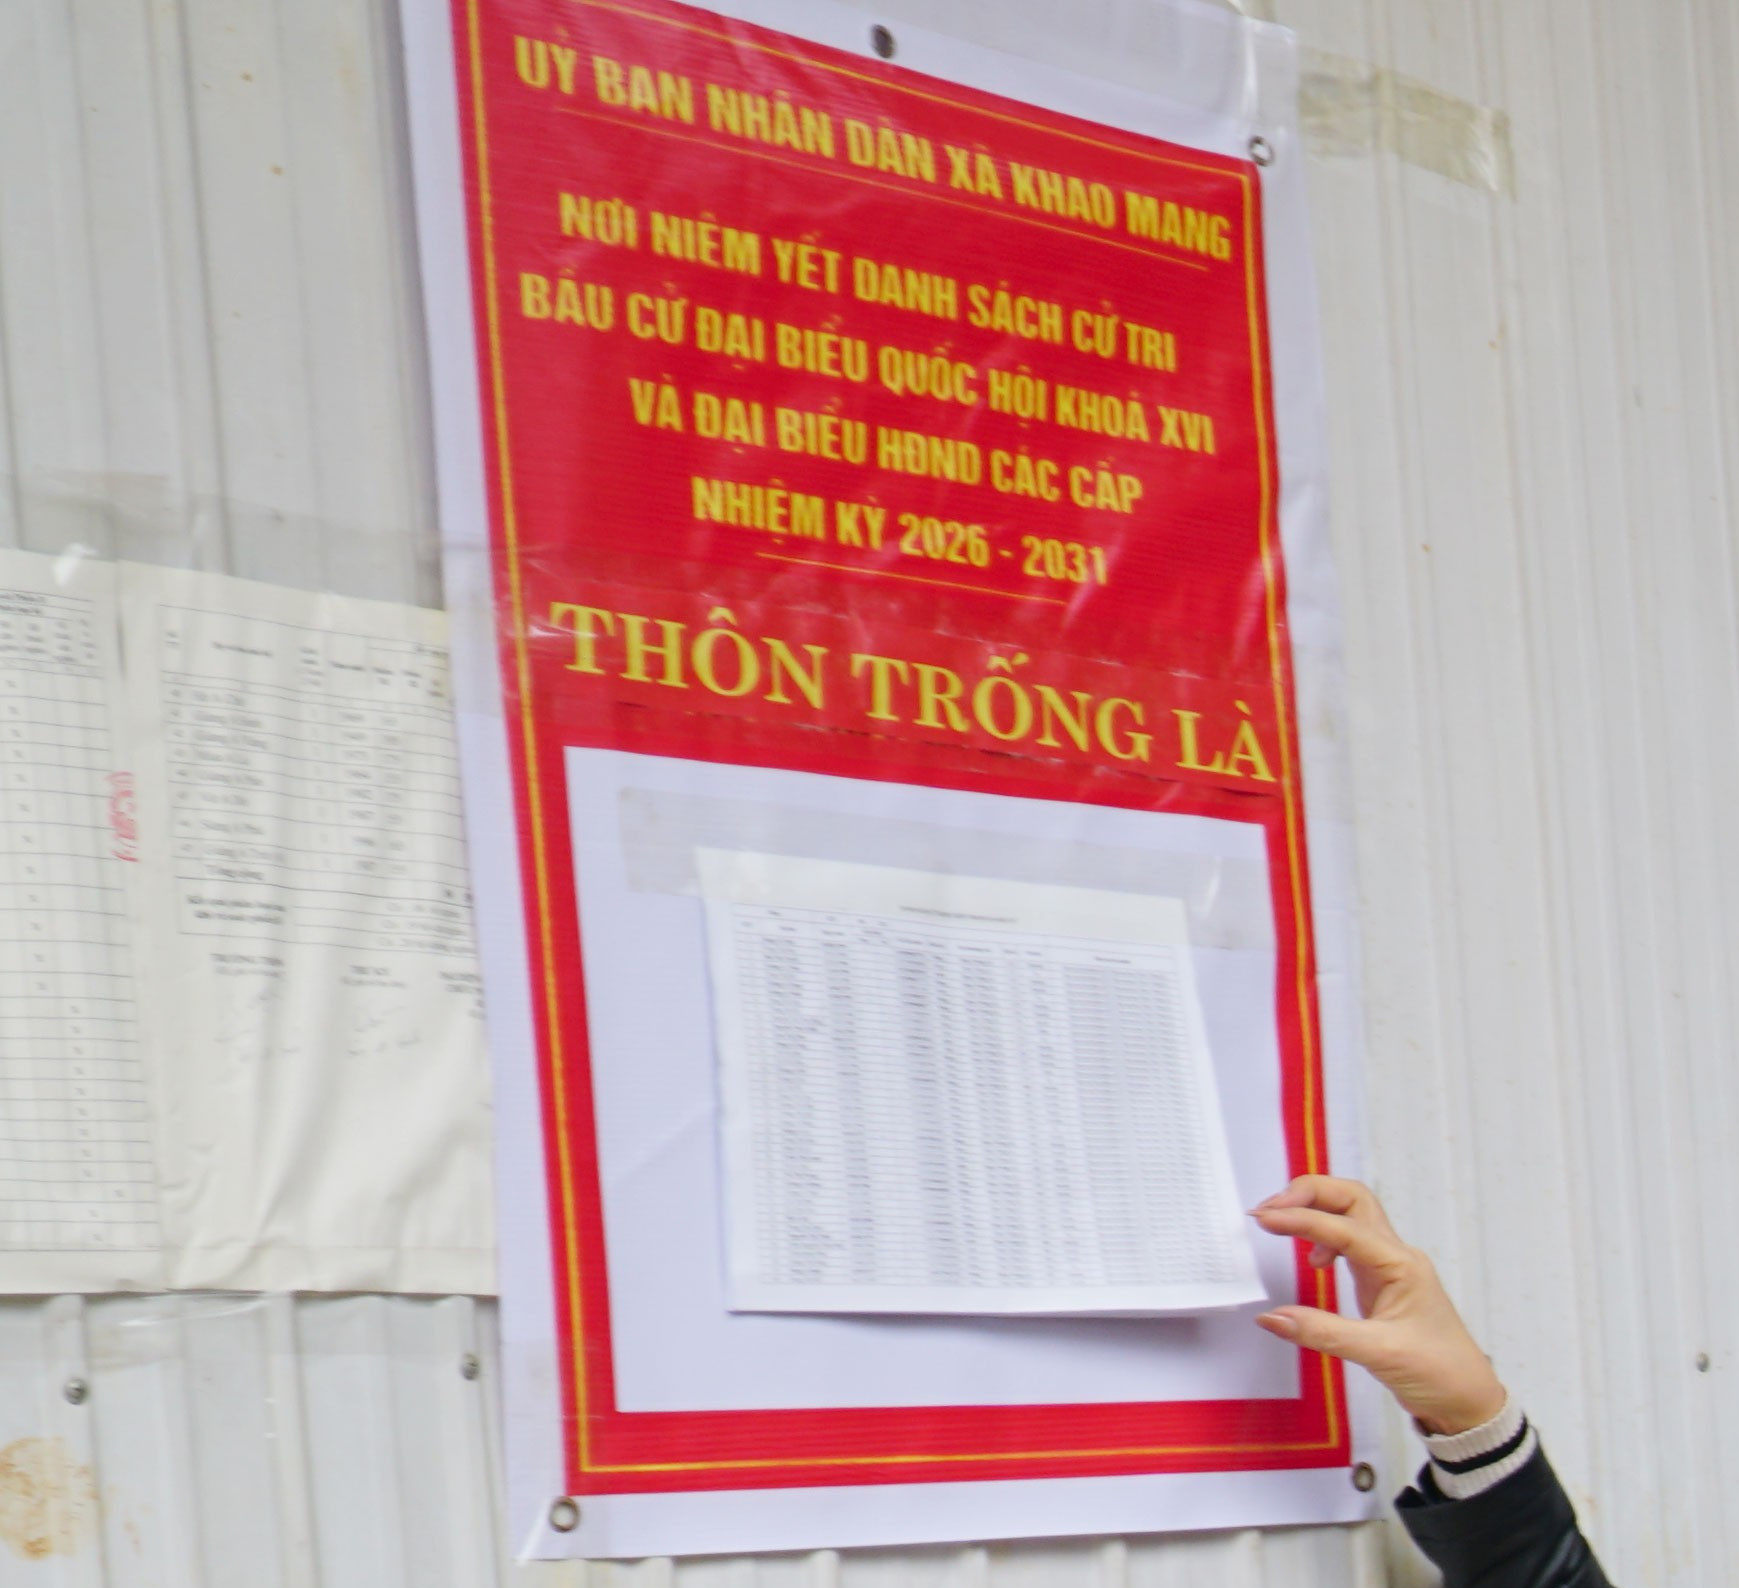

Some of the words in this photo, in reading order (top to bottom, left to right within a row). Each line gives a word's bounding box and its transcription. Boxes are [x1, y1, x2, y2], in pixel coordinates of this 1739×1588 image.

[592, 54, 695, 125] BAN
[706, 87, 836, 159] NHÂN
[845, 116, 937, 184] DÂN
[1009, 161, 1117, 229] KHAO
[1123, 189, 1232, 262] MANG
[558, 192, 640, 249] NƠI
[650, 210, 762, 276] NIÊM
[771, 230, 843, 293] YẾT
[852, 256, 958, 321] DANH
[967, 279, 1063, 344] SÁCH
[1070, 300, 1120, 359] CỬ
[1124, 321, 1178, 373] TRI
[626, 280, 690, 345] CỬ
[694, 304, 766, 370] ĐẠI
[775, 313, 869, 383] BIỂU
[878, 341, 978, 405] QUỐC
[988, 364, 1047, 429] HỘI
[1055, 391, 1149, 443] KHOÁ
[1157, 404, 1216, 455] XVI
[628, 372, 684, 432] VÀ
[693, 391, 767, 454] ĐẠI
[775, 397, 868, 465] BIỂU
[876, 426, 983, 486] HĐND
[990, 445, 1061, 503] CÁC
[1068, 456, 1143, 514] CẤP
[690, 475, 827, 545] NHIỆM
[834, 495, 888, 551] KỲ
[898, 512, 991, 568] 2026
[1020, 534, 1109, 586] 2031
[549, 601, 830, 710] THÔN
[849, 652, 1154, 763] TRỐNG
[1171, 699, 1277, 782] LÀ
